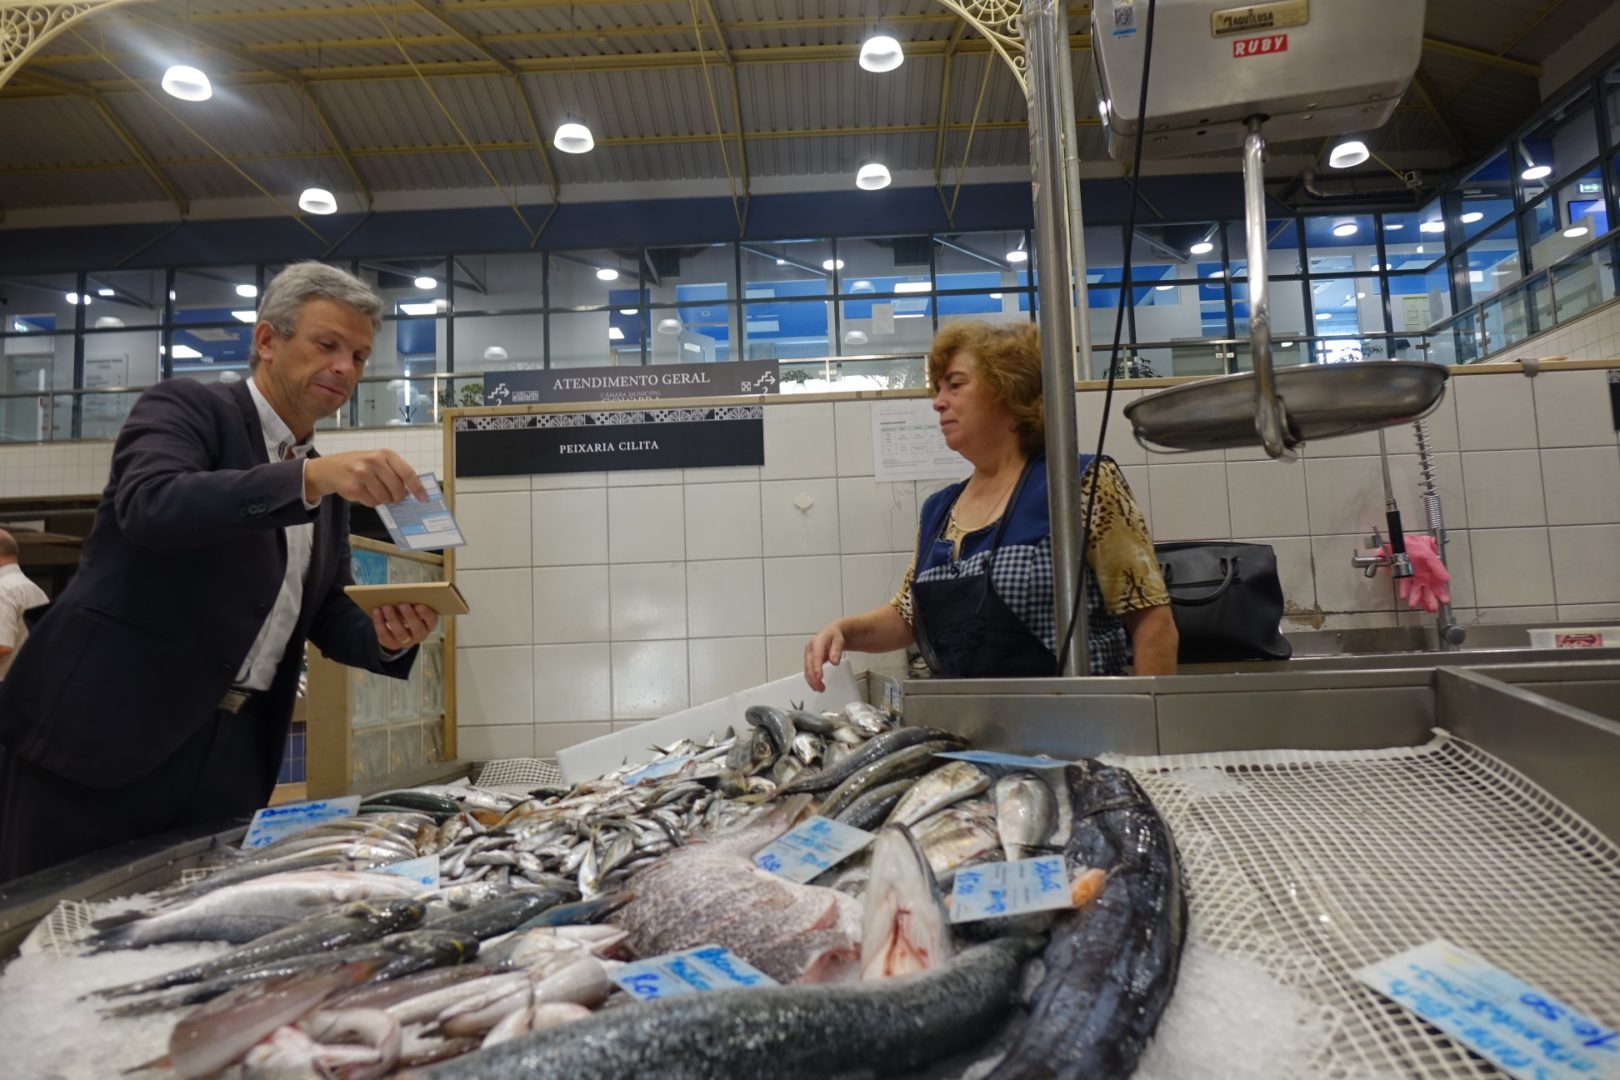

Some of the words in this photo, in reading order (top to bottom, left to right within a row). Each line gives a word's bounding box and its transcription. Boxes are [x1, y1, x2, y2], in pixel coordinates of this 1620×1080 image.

[1234, 35, 1285, 56] RUBY
[553, 375, 659, 390] ATENDIMENTO
[662, 372, 711, 385] GERAL
[600, 391, 627, 399] CÂMARA
[559, 442, 616, 455] PEIXARIA
[619, 440, 660, 452] CILITA
